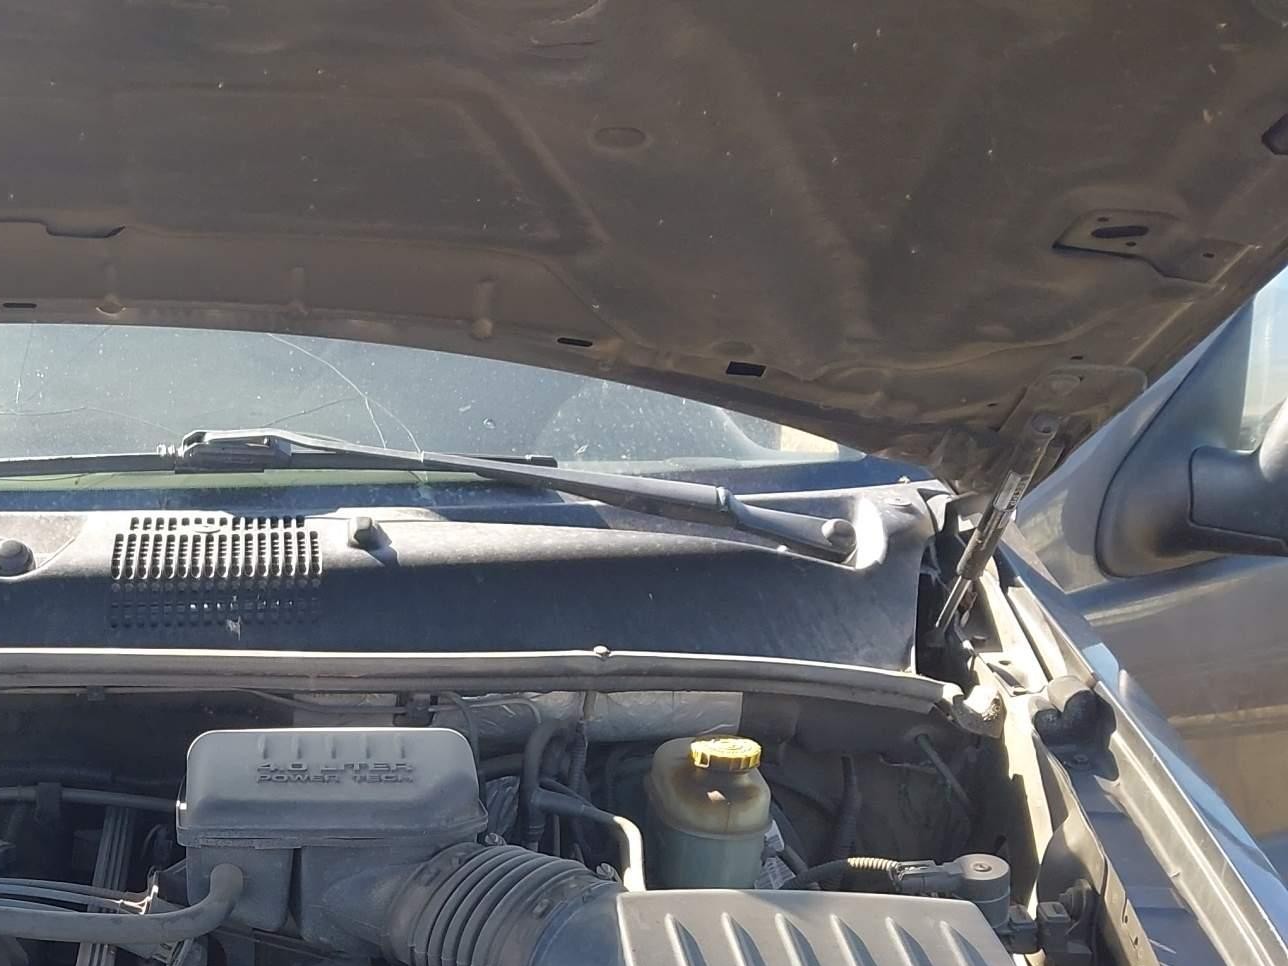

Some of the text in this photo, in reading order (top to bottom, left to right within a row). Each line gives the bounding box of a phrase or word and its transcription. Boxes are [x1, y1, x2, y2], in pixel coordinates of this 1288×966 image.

[257, 761, 414, 773] 4.0 LITER
[257, 773, 414, 784] POWER TECH
